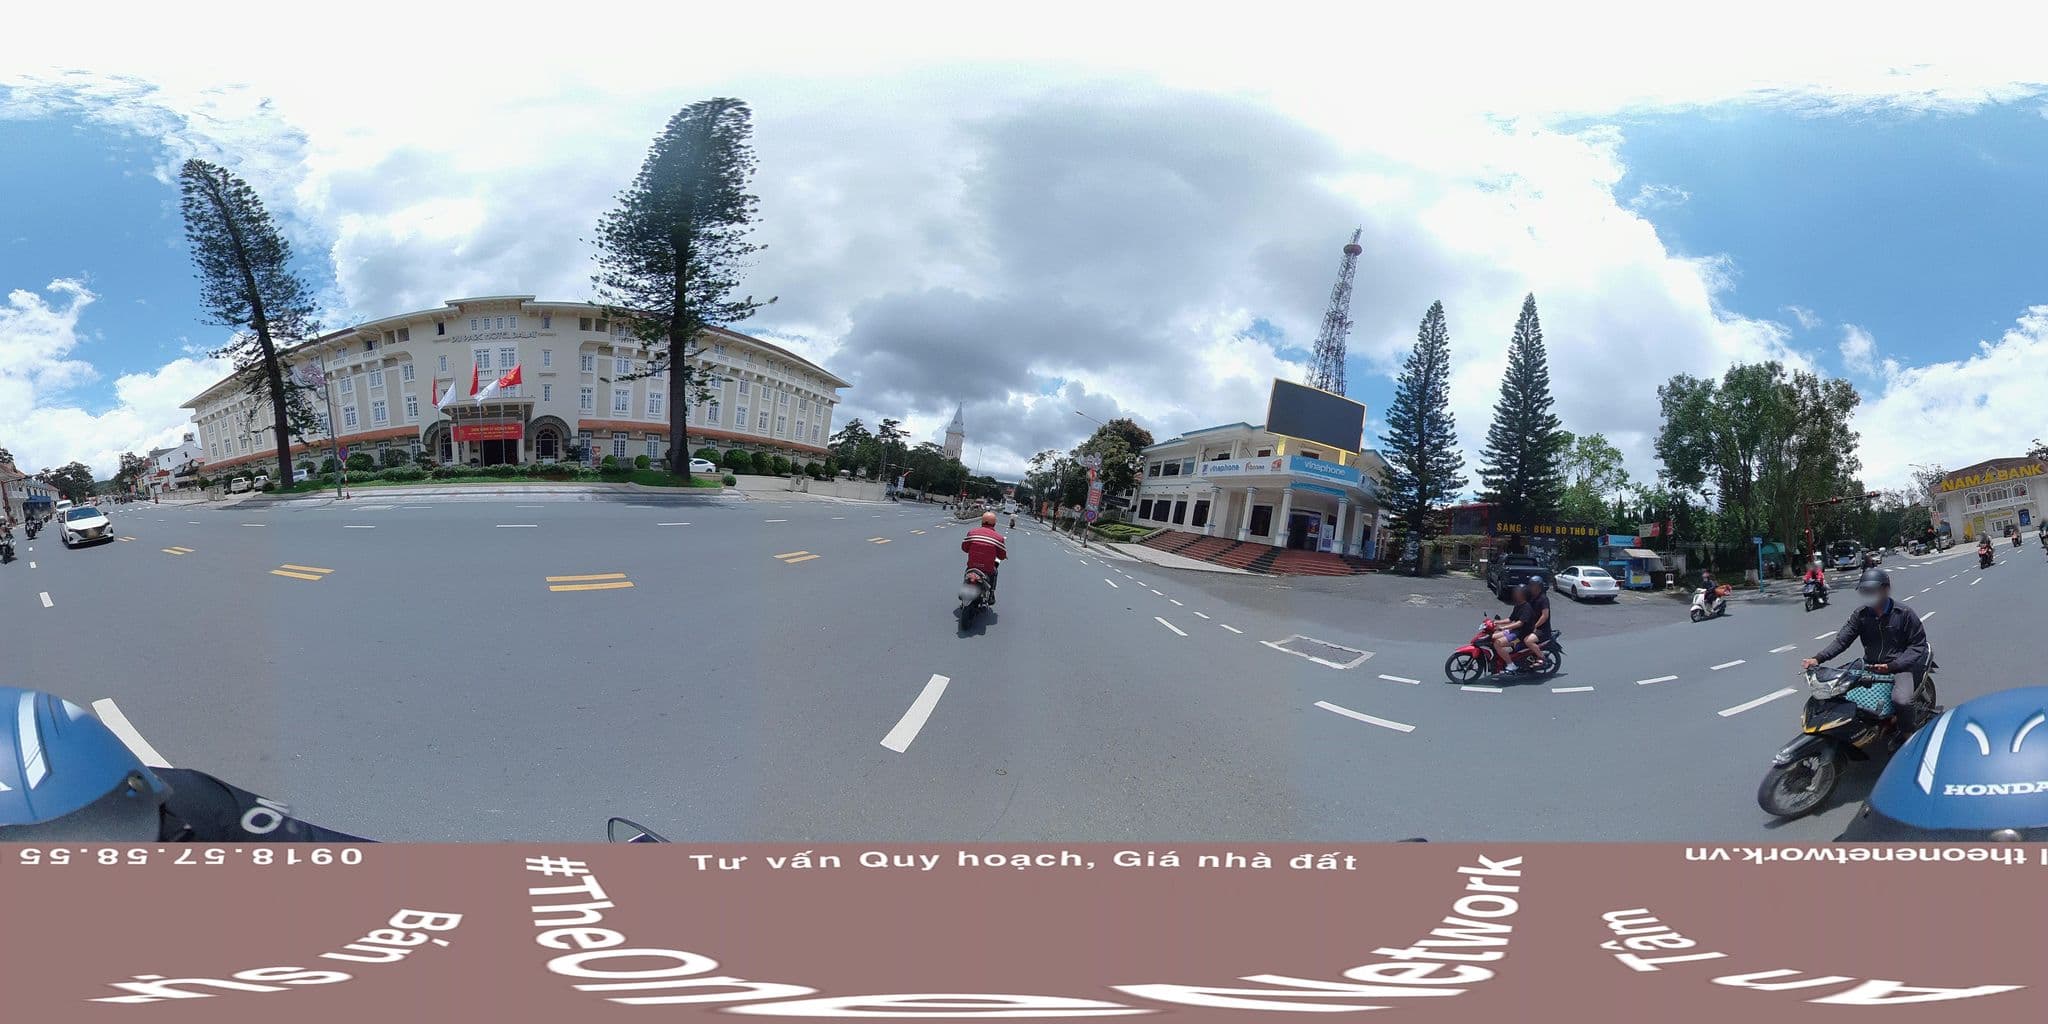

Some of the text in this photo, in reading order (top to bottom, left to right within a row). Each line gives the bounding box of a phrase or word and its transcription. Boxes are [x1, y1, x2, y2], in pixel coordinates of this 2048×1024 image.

[1304, 460, 1345, 476] vinaphone
[1941, 473, 1981, 491] NAM
[1997, 463, 2042, 480] BANK
